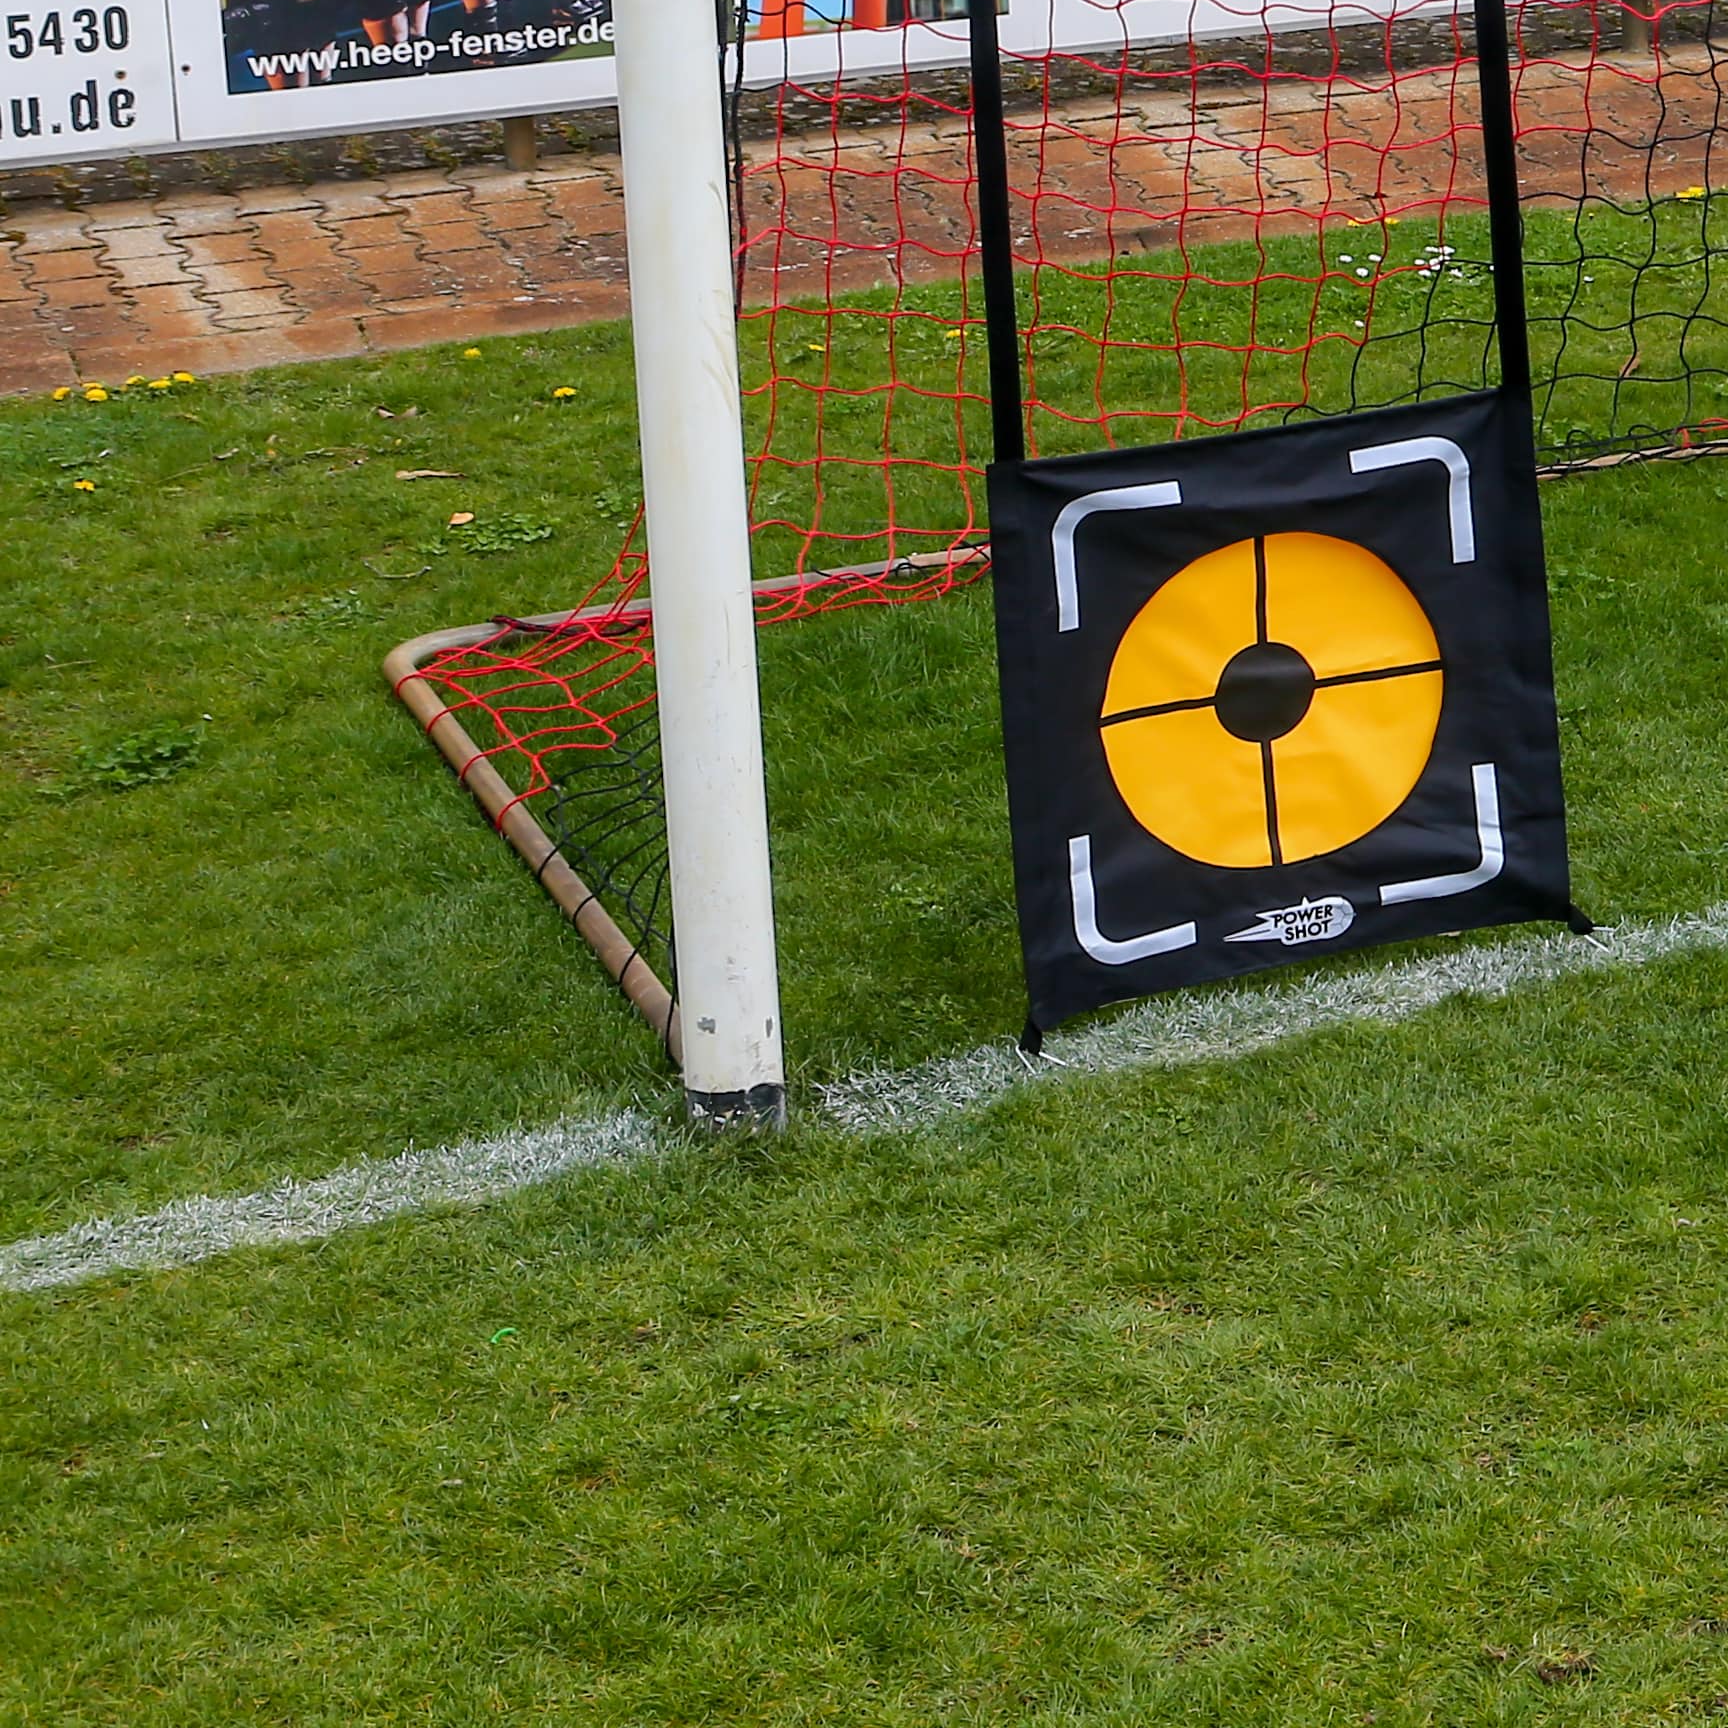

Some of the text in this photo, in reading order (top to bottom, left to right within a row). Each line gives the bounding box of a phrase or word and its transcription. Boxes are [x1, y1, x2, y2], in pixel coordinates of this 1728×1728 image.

[6, 6, 130, 59] 5430
[247, 17, 615, 77] www.heep-fenster.de
[0, 79, 136, 139] u.de
[1269, 904, 1334, 928] POWER
[1284, 919, 1334, 941] SHOT
